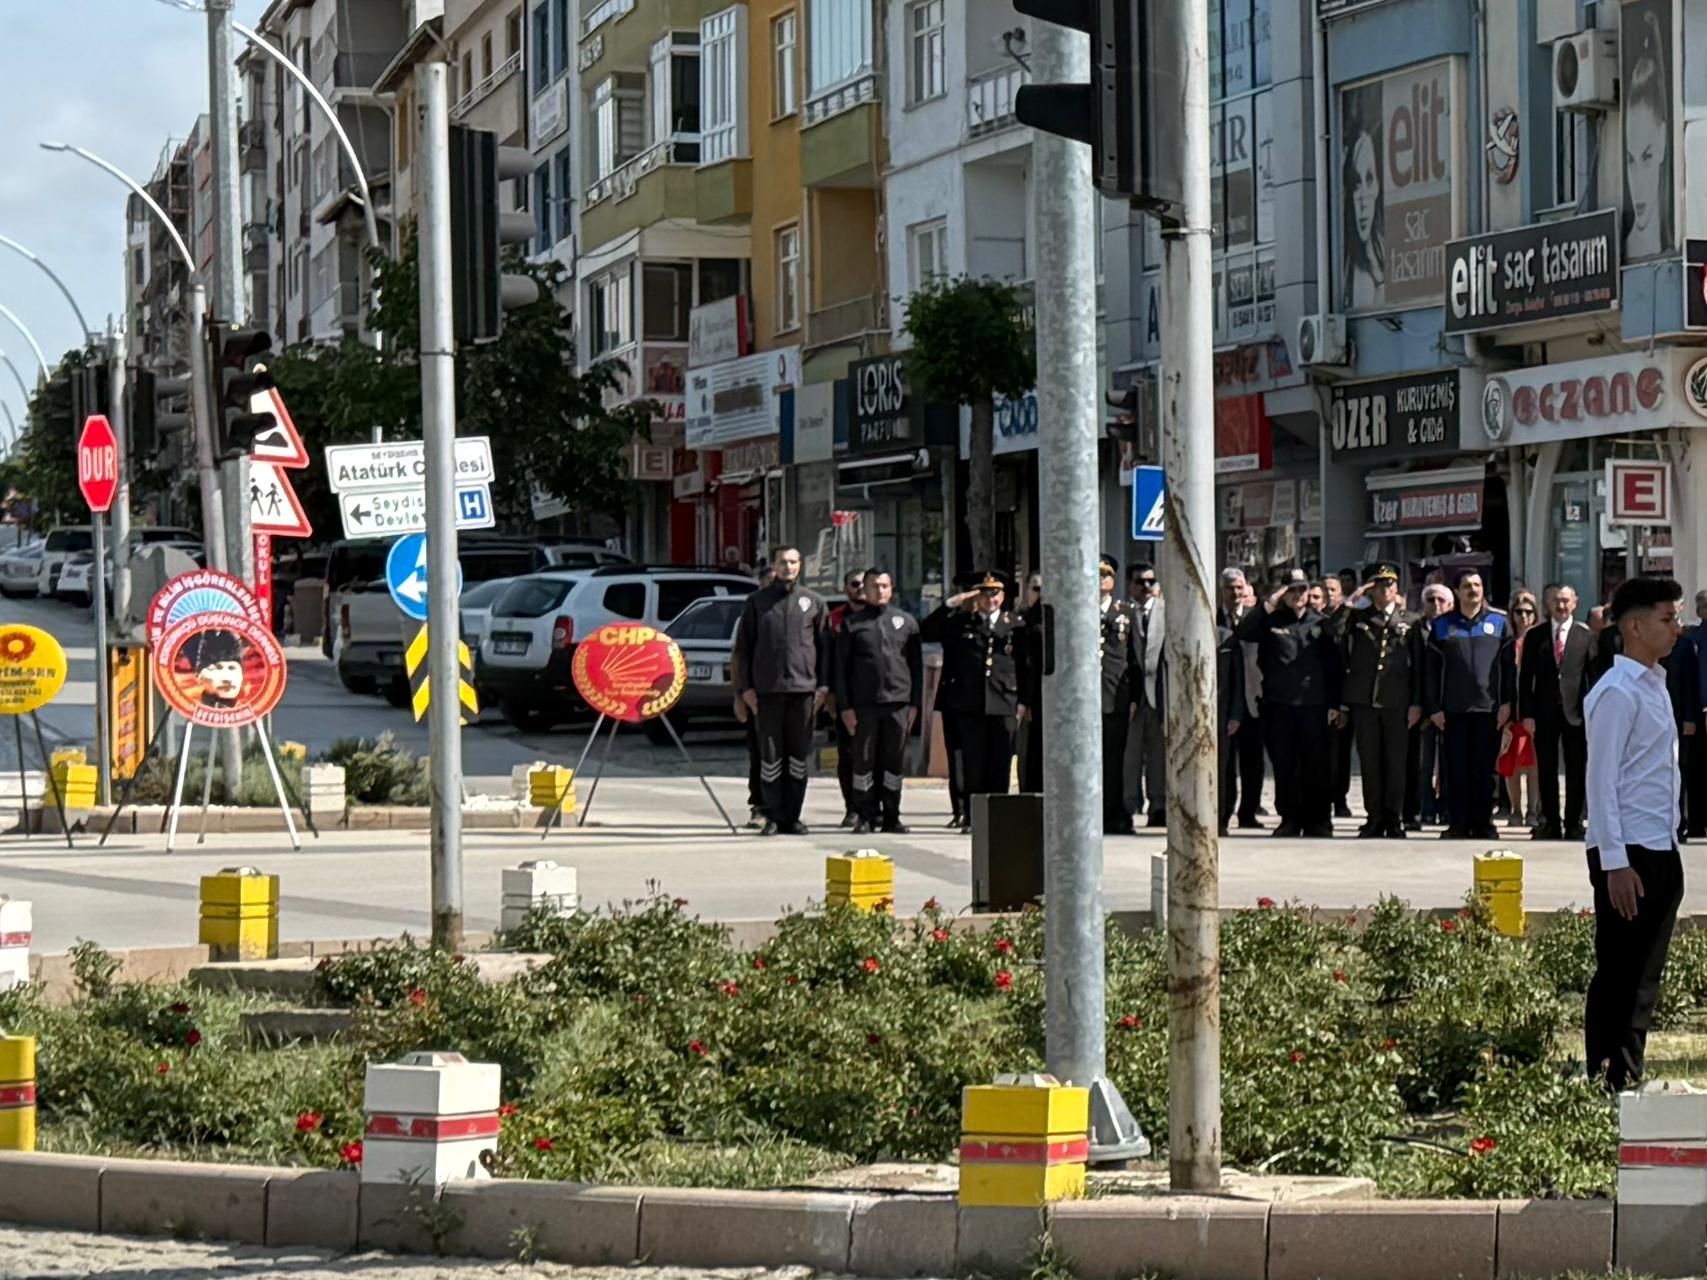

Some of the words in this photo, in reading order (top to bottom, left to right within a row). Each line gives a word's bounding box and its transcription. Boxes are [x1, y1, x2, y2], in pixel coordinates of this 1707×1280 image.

[1389, 77, 1446, 188] elit
[1451, 243, 1498, 319] elit
[1504, 248, 1536, 293] saç
[1542, 234, 1608, 284] tasarım
[857, 361, 903, 416] LORIS
[1332, 386, 1388, 451] ÖZER
[1396, 376, 1456, 413] KURUYEMİŞ
[1513, 366, 1664, 426] eczane
[1407, 418, 1417, 444] &
[82, 445, 114, 482] DUR
[338, 460, 408, 482] Atatürk
[1624, 473, 1656, 512] E
[257, 533, 270, 585] OKUL
[599, 627, 656, 646] CHP
